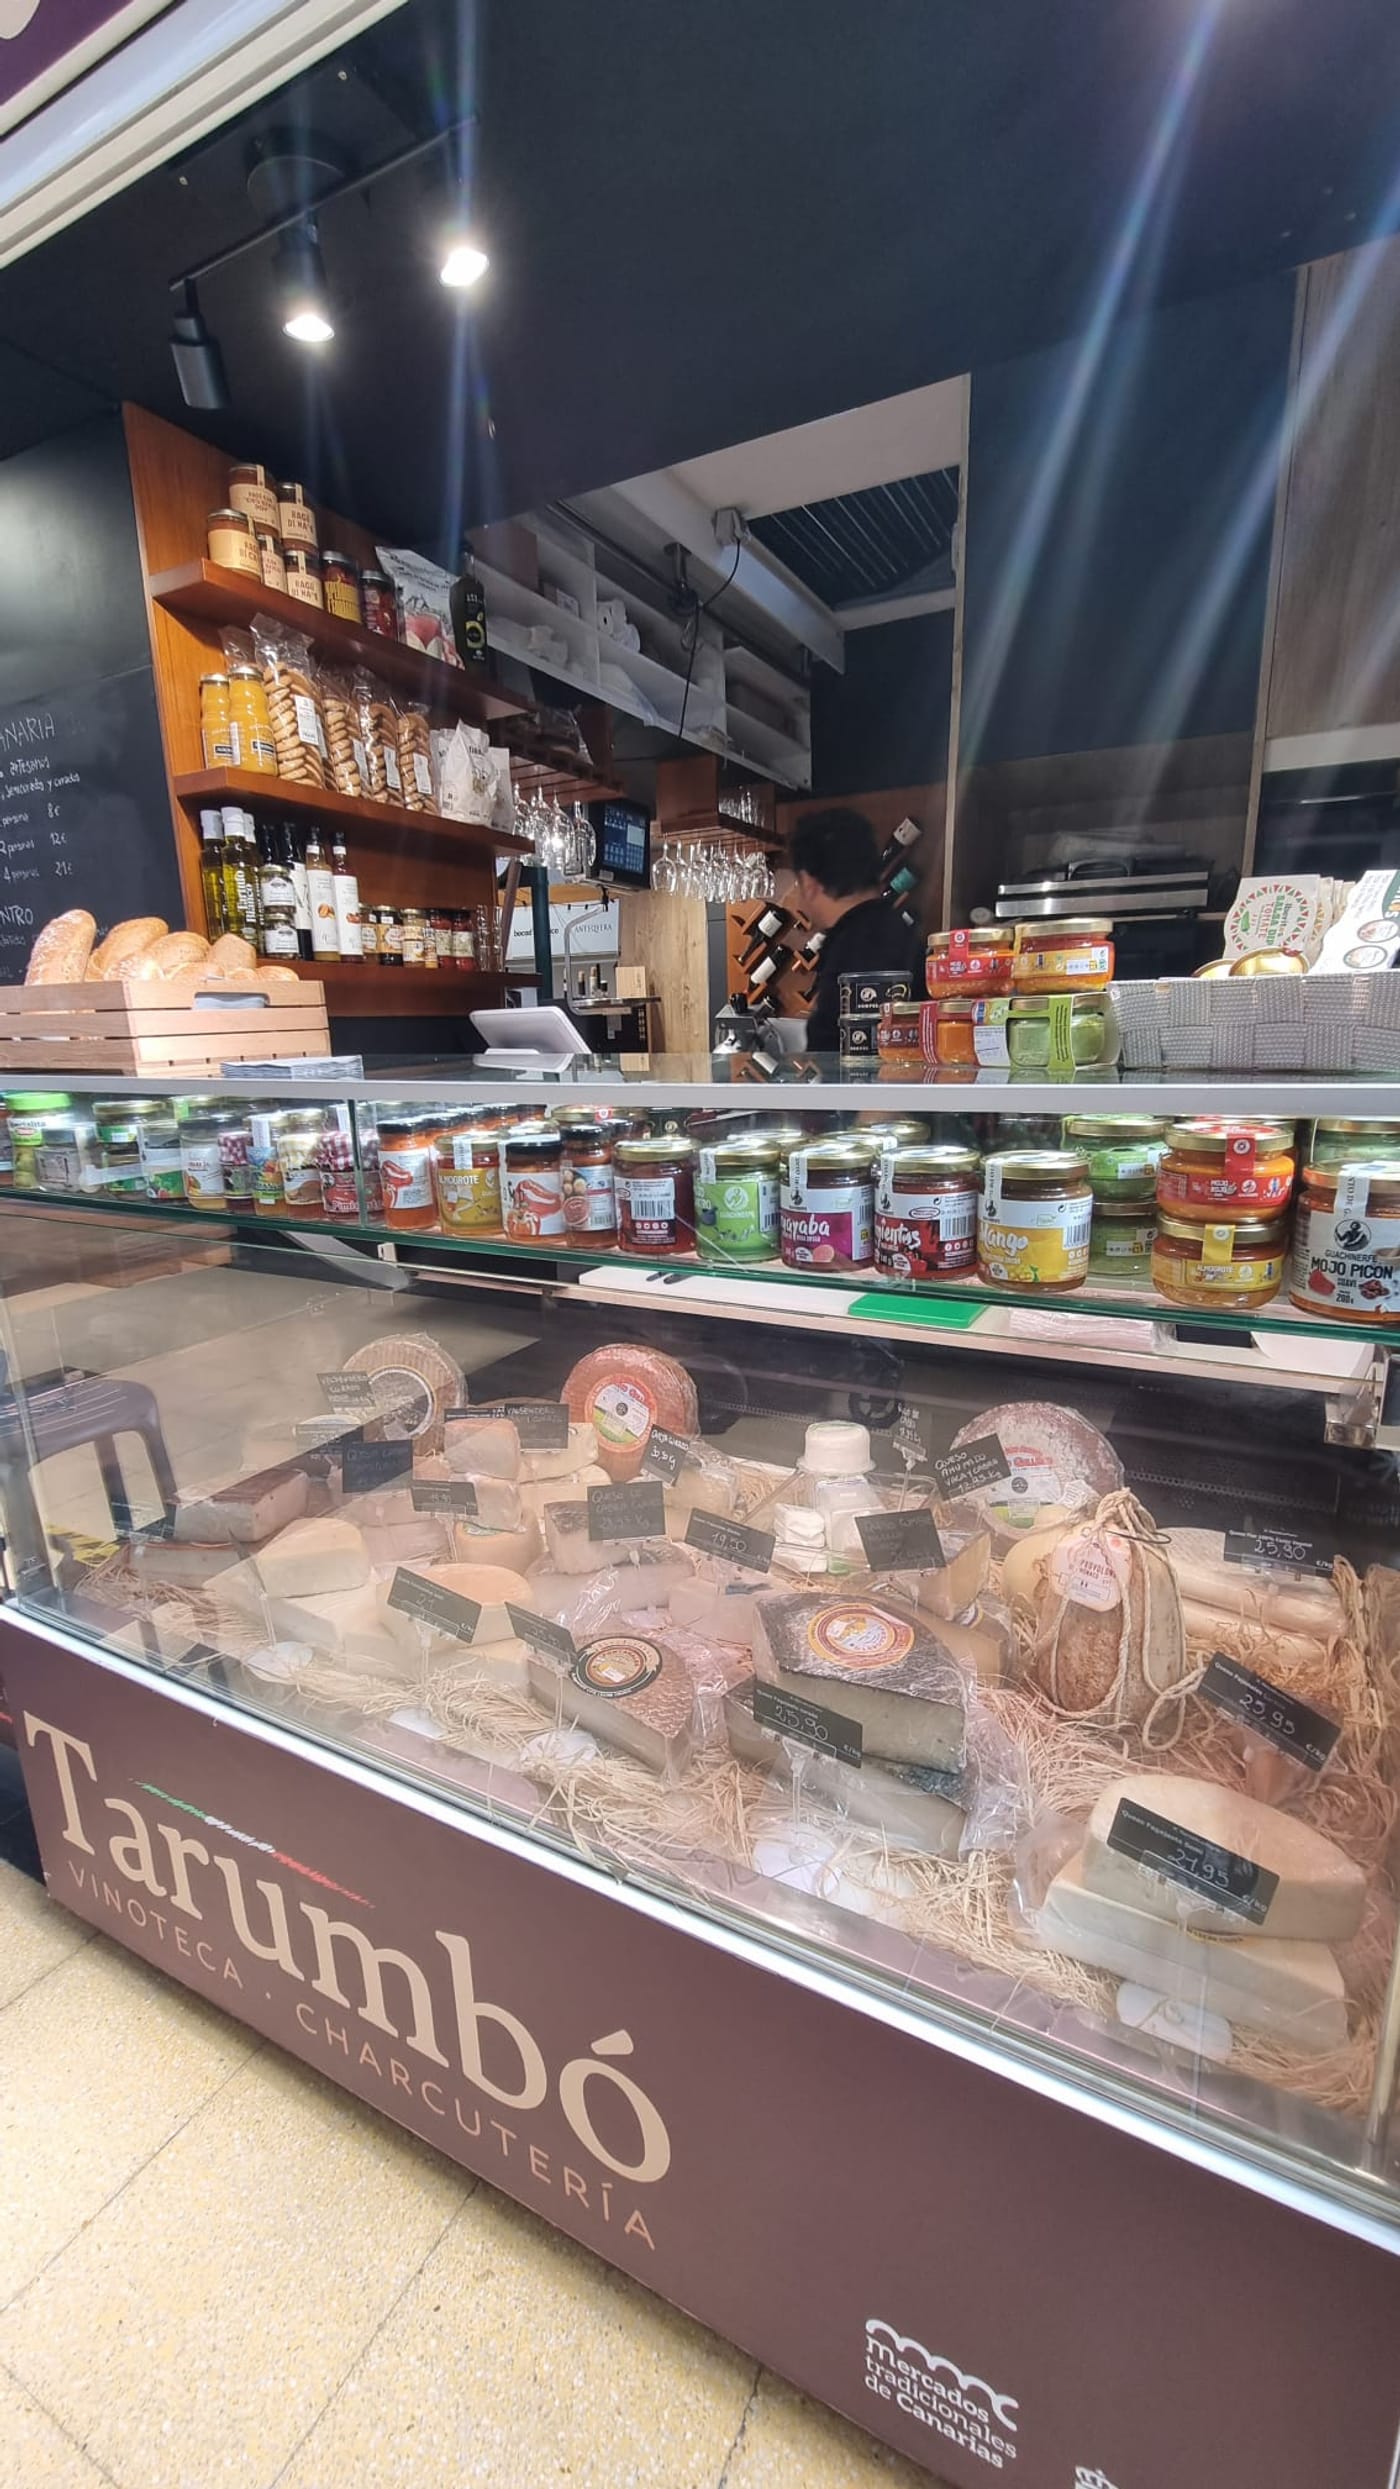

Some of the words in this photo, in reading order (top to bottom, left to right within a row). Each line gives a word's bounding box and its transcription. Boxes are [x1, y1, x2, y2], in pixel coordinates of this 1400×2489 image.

[781, 1212, 830, 1241] uayaba
[1311, 1257, 1347, 1275] MOJO
[1350, 1263, 1394, 1279] PICON
[934, 1451, 967, 1471] QUESO
[1254, 1539, 1306, 1560] 25,90
[775, 1705, 829, 1741] 25,90
[24, 1710, 671, 2183] Tarumbó
[68, 1859, 243, 1989] VINOTECA
[295, 2001, 656, 2250] CHARCUTERÍA
[865, 2335, 990, 2423] mercados
[865, 2354, 1017, 2459] tradicionales
[864, 2374, 892, 2400] de
[896, 2391, 1004, 2469] Canarias
